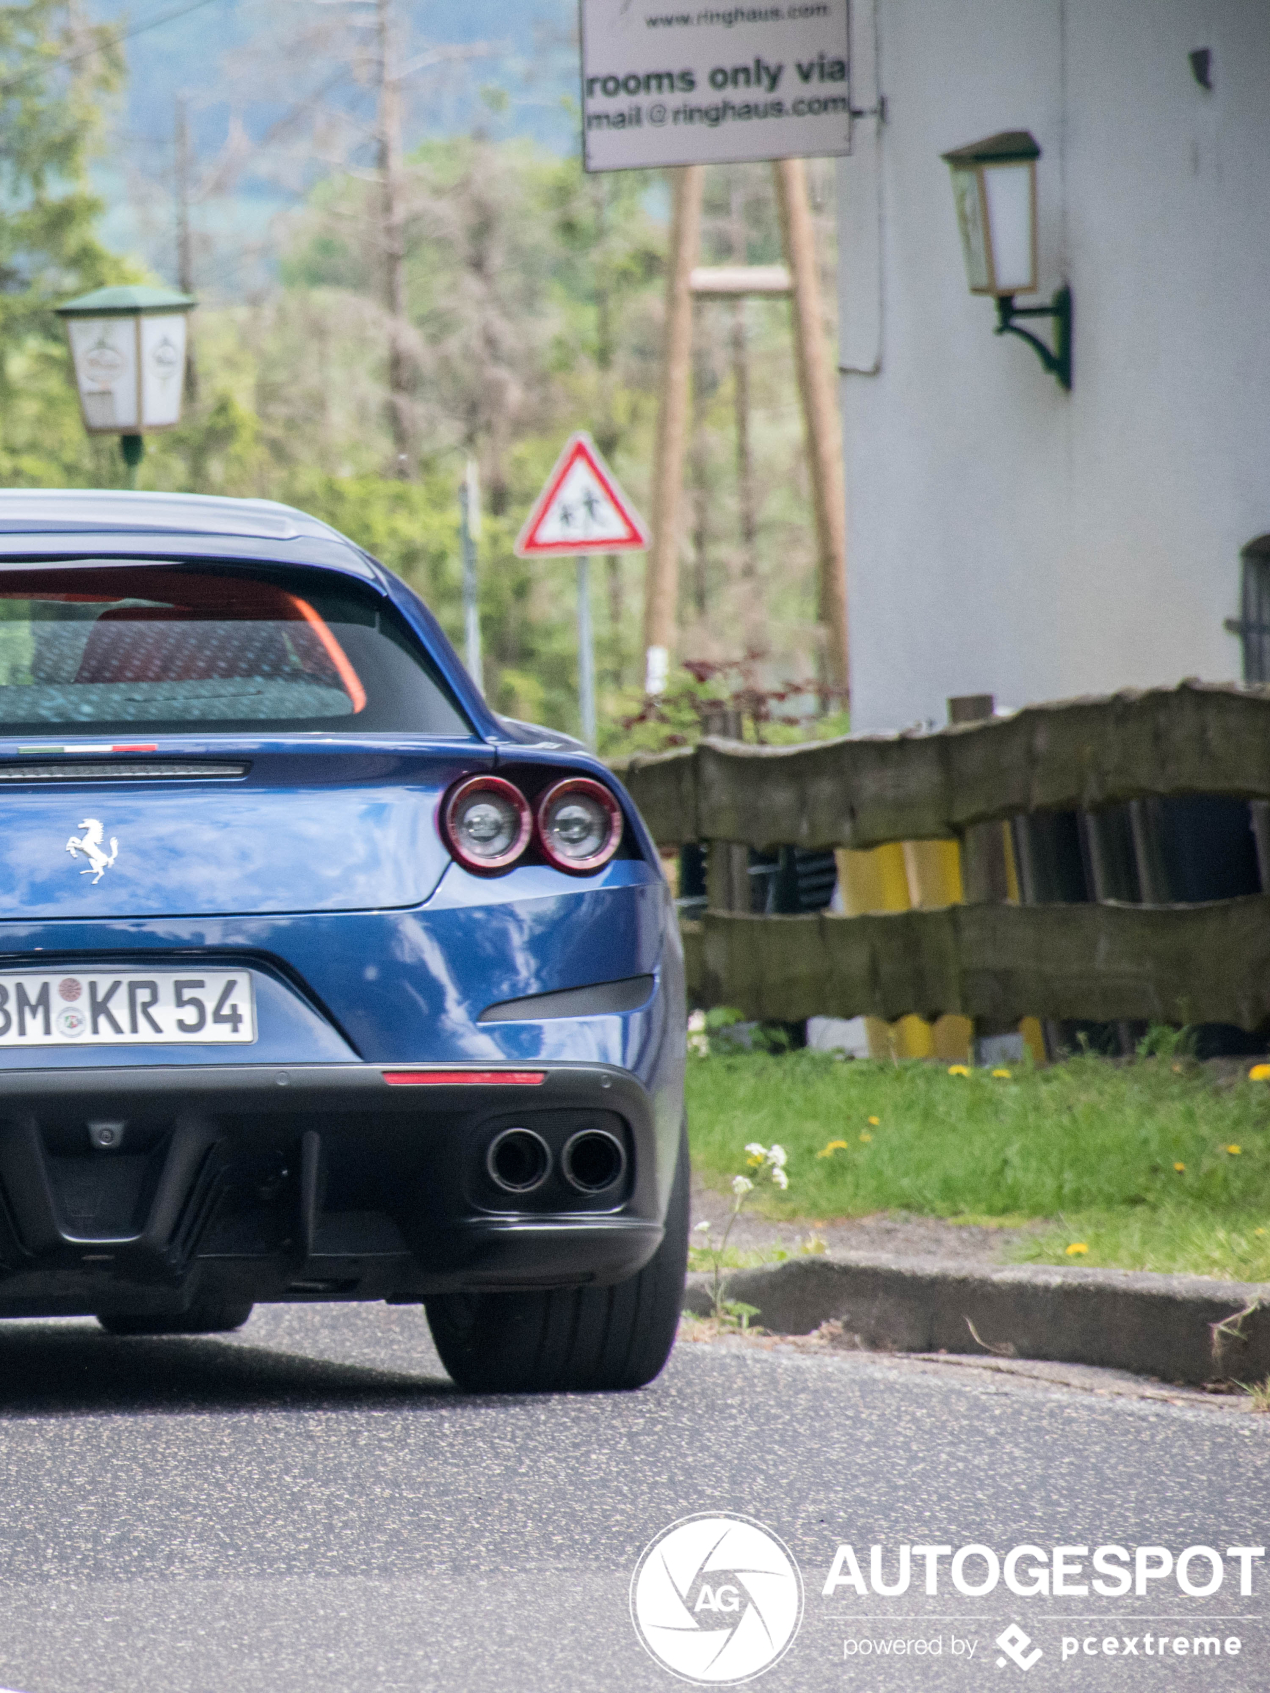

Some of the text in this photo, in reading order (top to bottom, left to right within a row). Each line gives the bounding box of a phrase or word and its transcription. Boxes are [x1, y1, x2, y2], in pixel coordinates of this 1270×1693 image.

[586, 52, 846, 97] rooms only via
[89, 980, 163, 1035] KR
[174, 980, 243, 1033] 54
